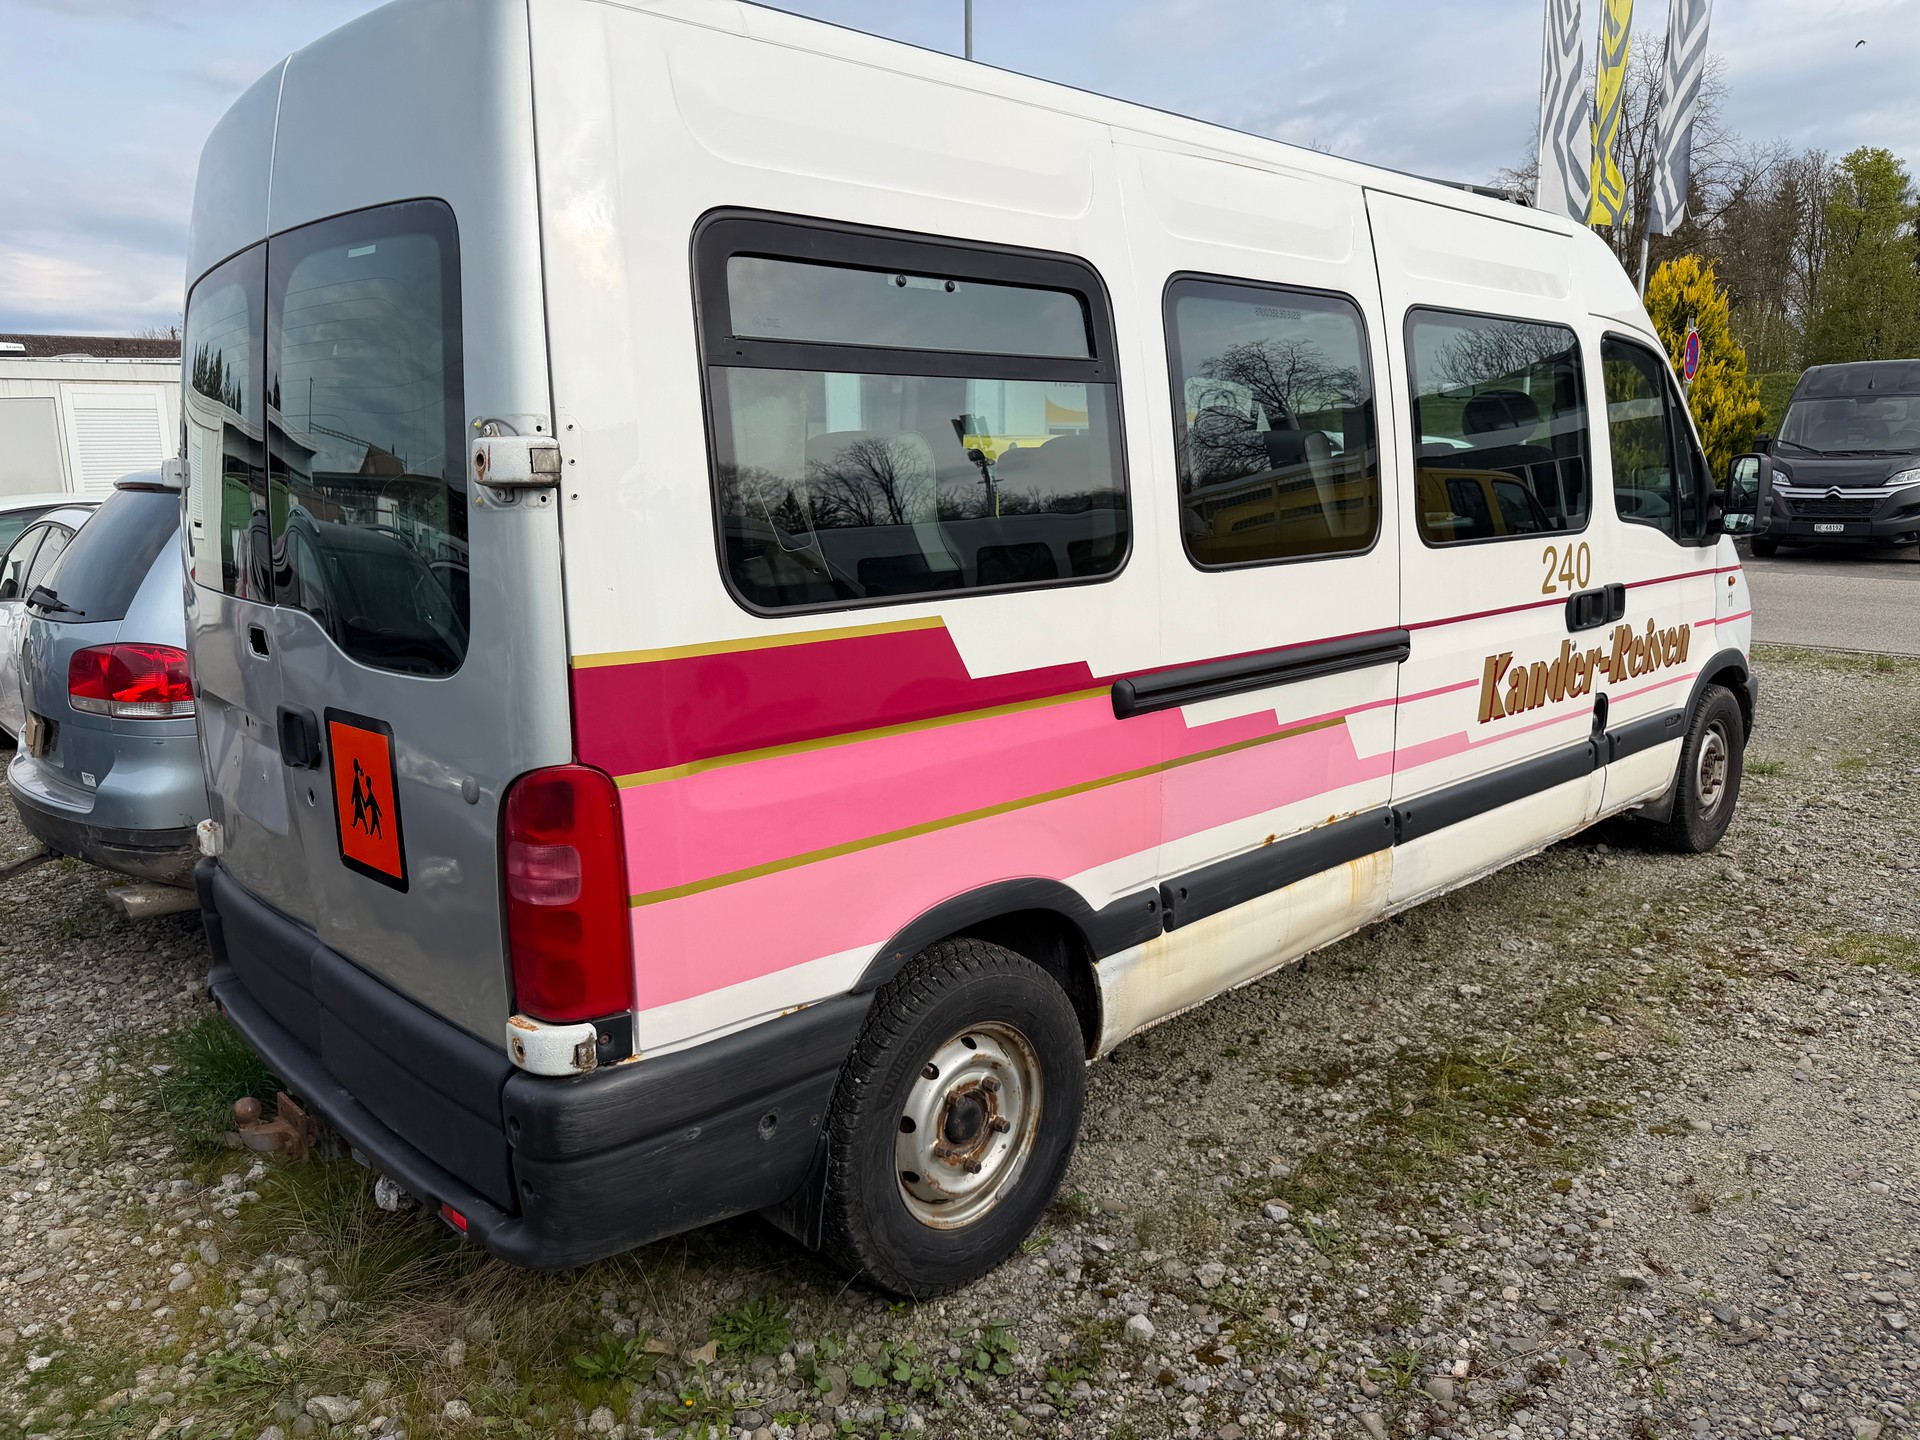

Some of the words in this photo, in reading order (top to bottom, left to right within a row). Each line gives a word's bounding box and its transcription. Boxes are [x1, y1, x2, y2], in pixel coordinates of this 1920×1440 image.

[1542, 541, 1590, 594] 240
[1477, 617, 1690, 724] Kander-Reisen
[881, 1017, 940, 1100] UNIROYAL
